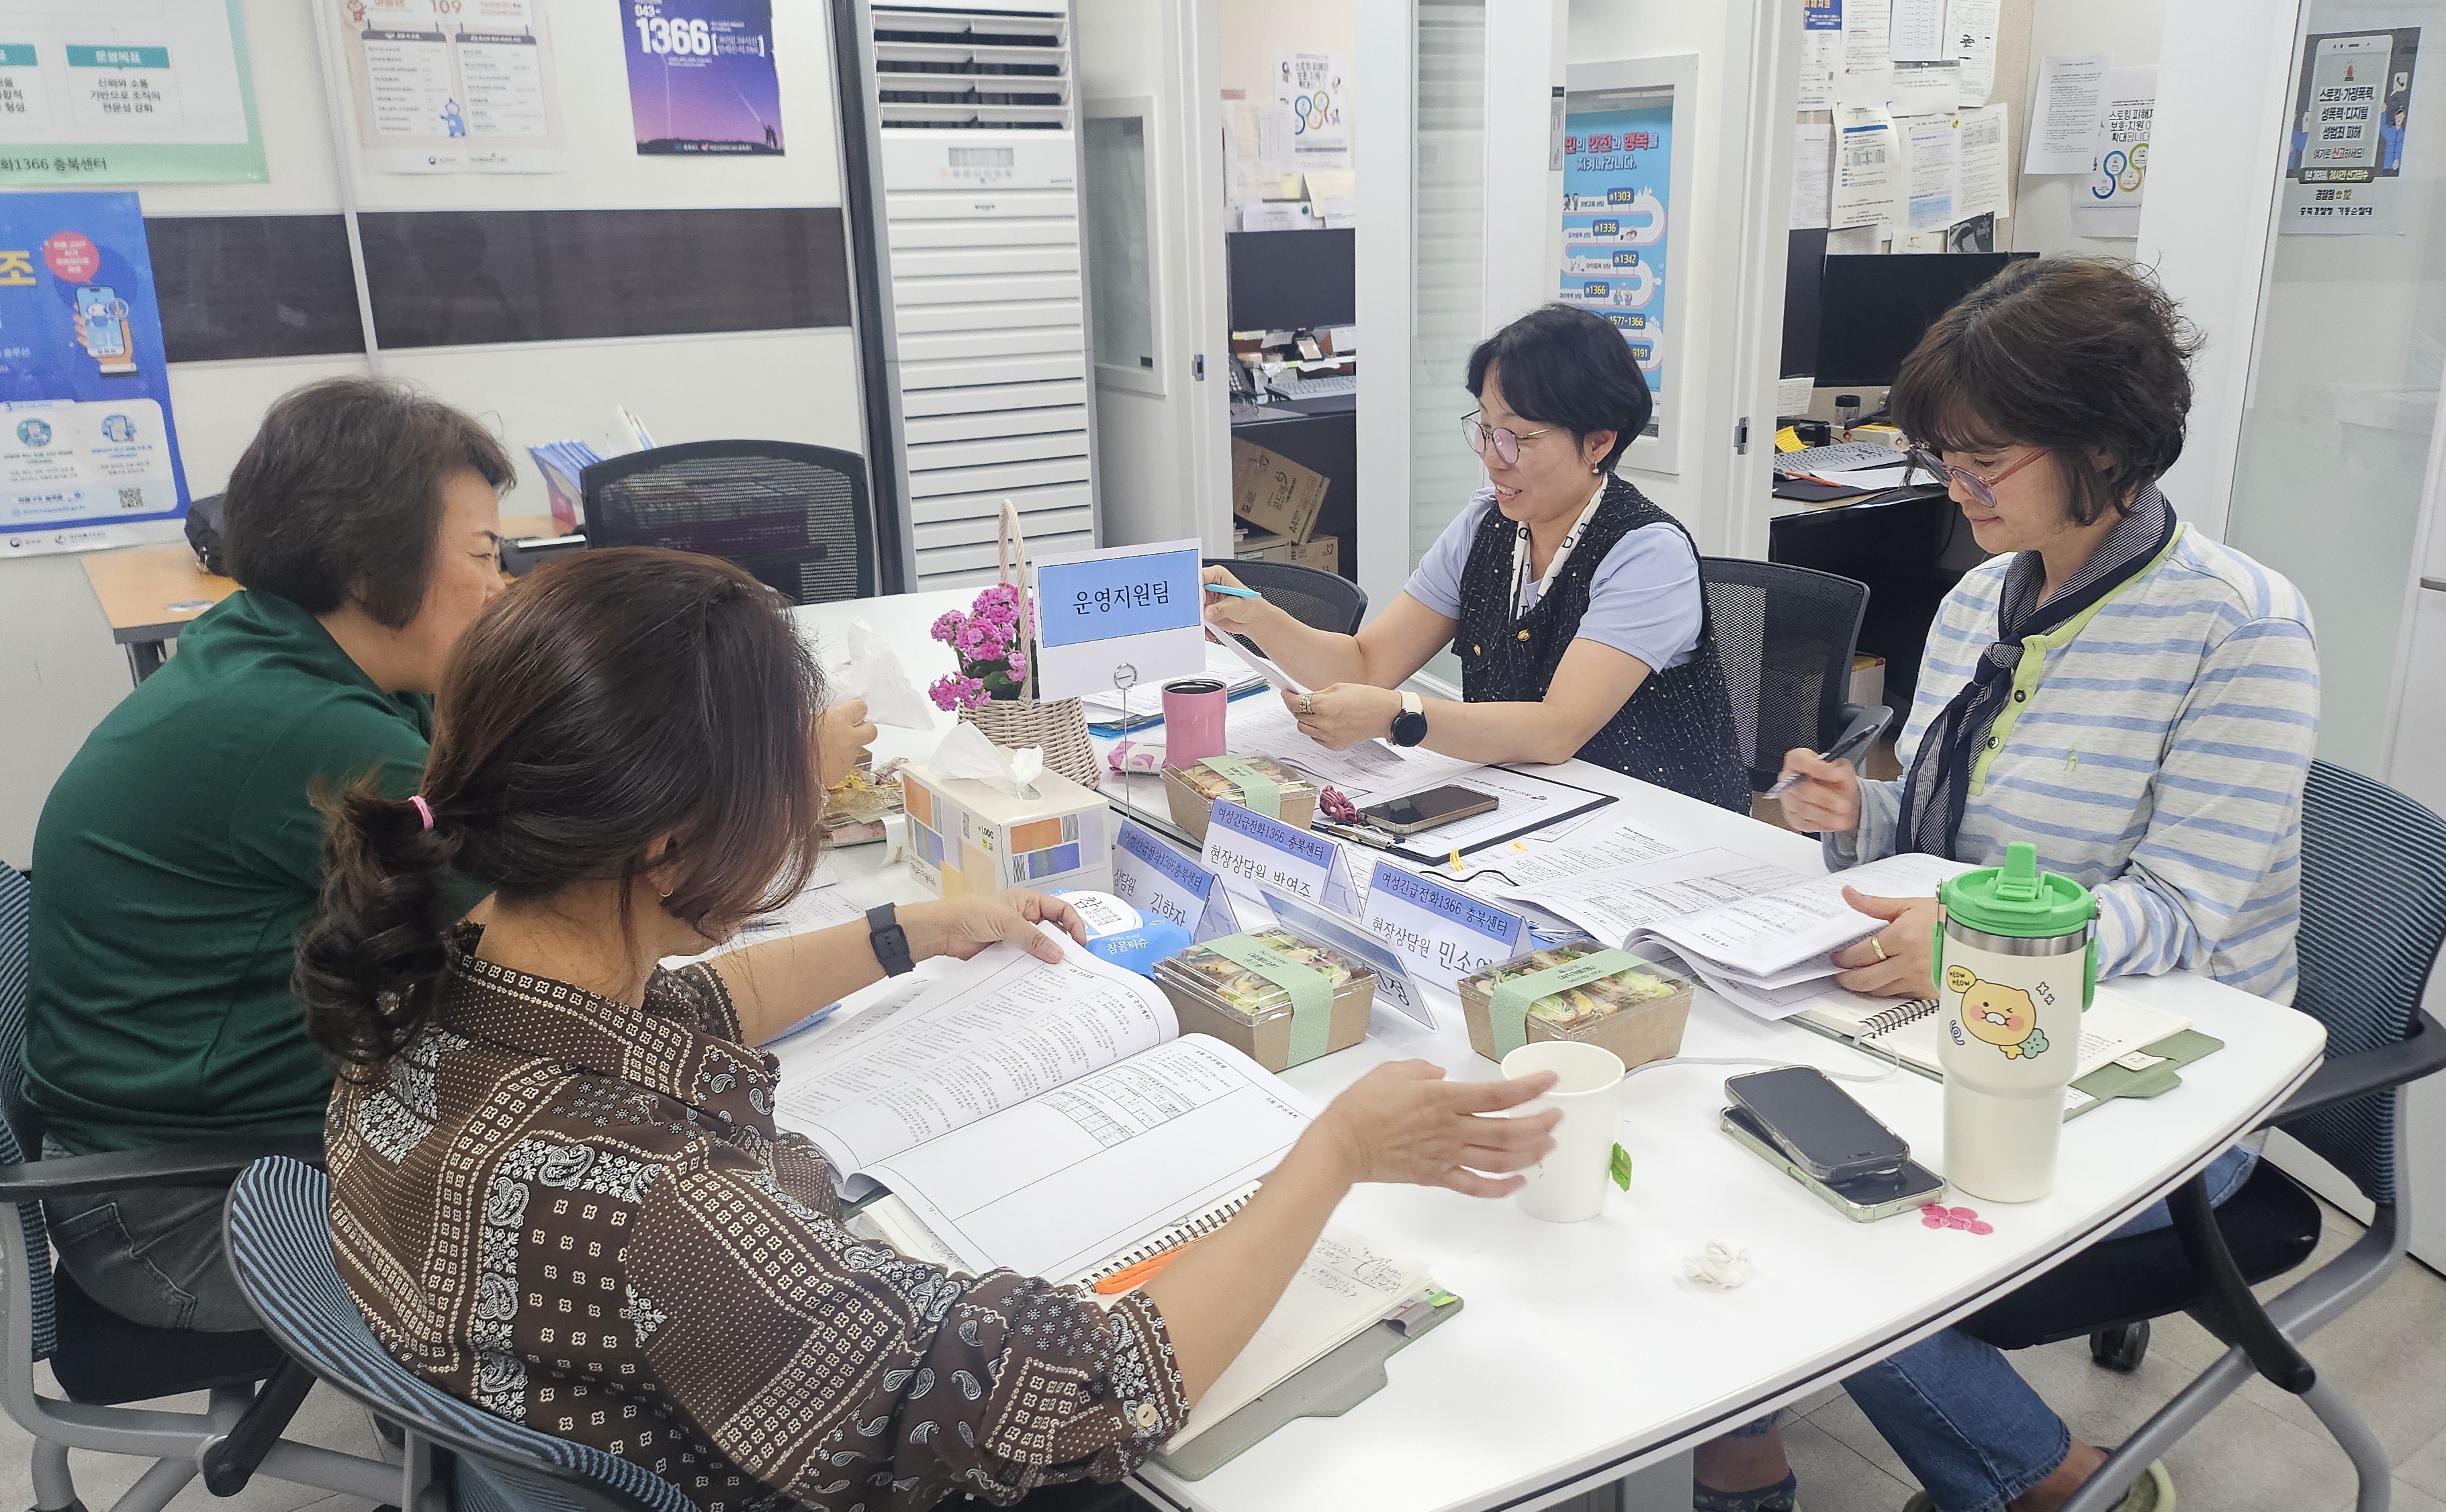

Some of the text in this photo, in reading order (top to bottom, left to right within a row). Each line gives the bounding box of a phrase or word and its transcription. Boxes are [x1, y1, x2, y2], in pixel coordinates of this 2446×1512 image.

[635, 16, 711, 56] 1366
[90, 90, 130, 100] 기반으로
[2110, 110, 2131, 120] 스토킹
[2110, 121, 2144, 132] 보호·지원
[2322, 125, 2361, 140] 성범죄 피해
[1588, 134, 1622, 153] 안전과
[1623, 132, 1660, 151] 행복을
[53, 157, 107, 172] 충북센터
[1613, 191, 1631, 202] 1303
[2315, 189, 2335, 201] 경찰청
[1599, 223, 1616, 233] 1336
[1619, 254, 1636, 264] 1342
[1589, 285, 1606, 295] 1366
[1609, 316, 1643, 327] 1577-1366
[1289, 520, 1298, 534] A4
[1073, 580, 1169, 616] 운영지원팀
[1218, 807, 1324, 861] 여성긴급전화1366 충북센터
[1210, 844, 1267, 880] 현장상담원
[1114, 869, 1136, 897] 상담원
[1381, 871, 1508, 937] 여성긴급전화1366 충북센터
[1373, 916, 1431, 959] 현장상담원
[1107, 937, 1149, 955] 참물티슈
